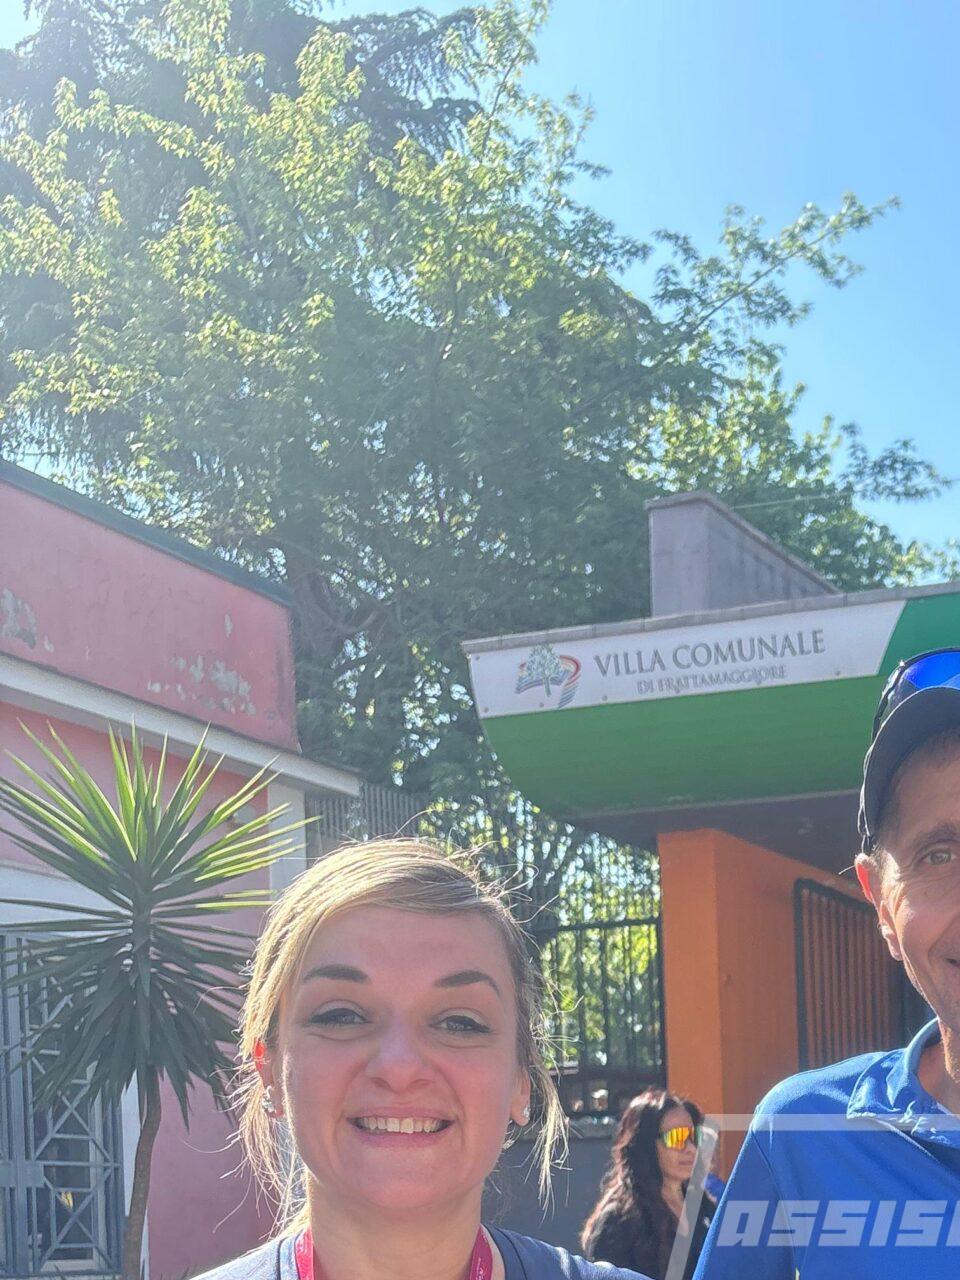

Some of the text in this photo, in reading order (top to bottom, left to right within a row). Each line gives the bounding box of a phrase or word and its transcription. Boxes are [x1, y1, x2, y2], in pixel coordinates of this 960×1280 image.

[593, 629, 827, 678] VILLA COMUNALE
[637, 679, 655, 695] DI
